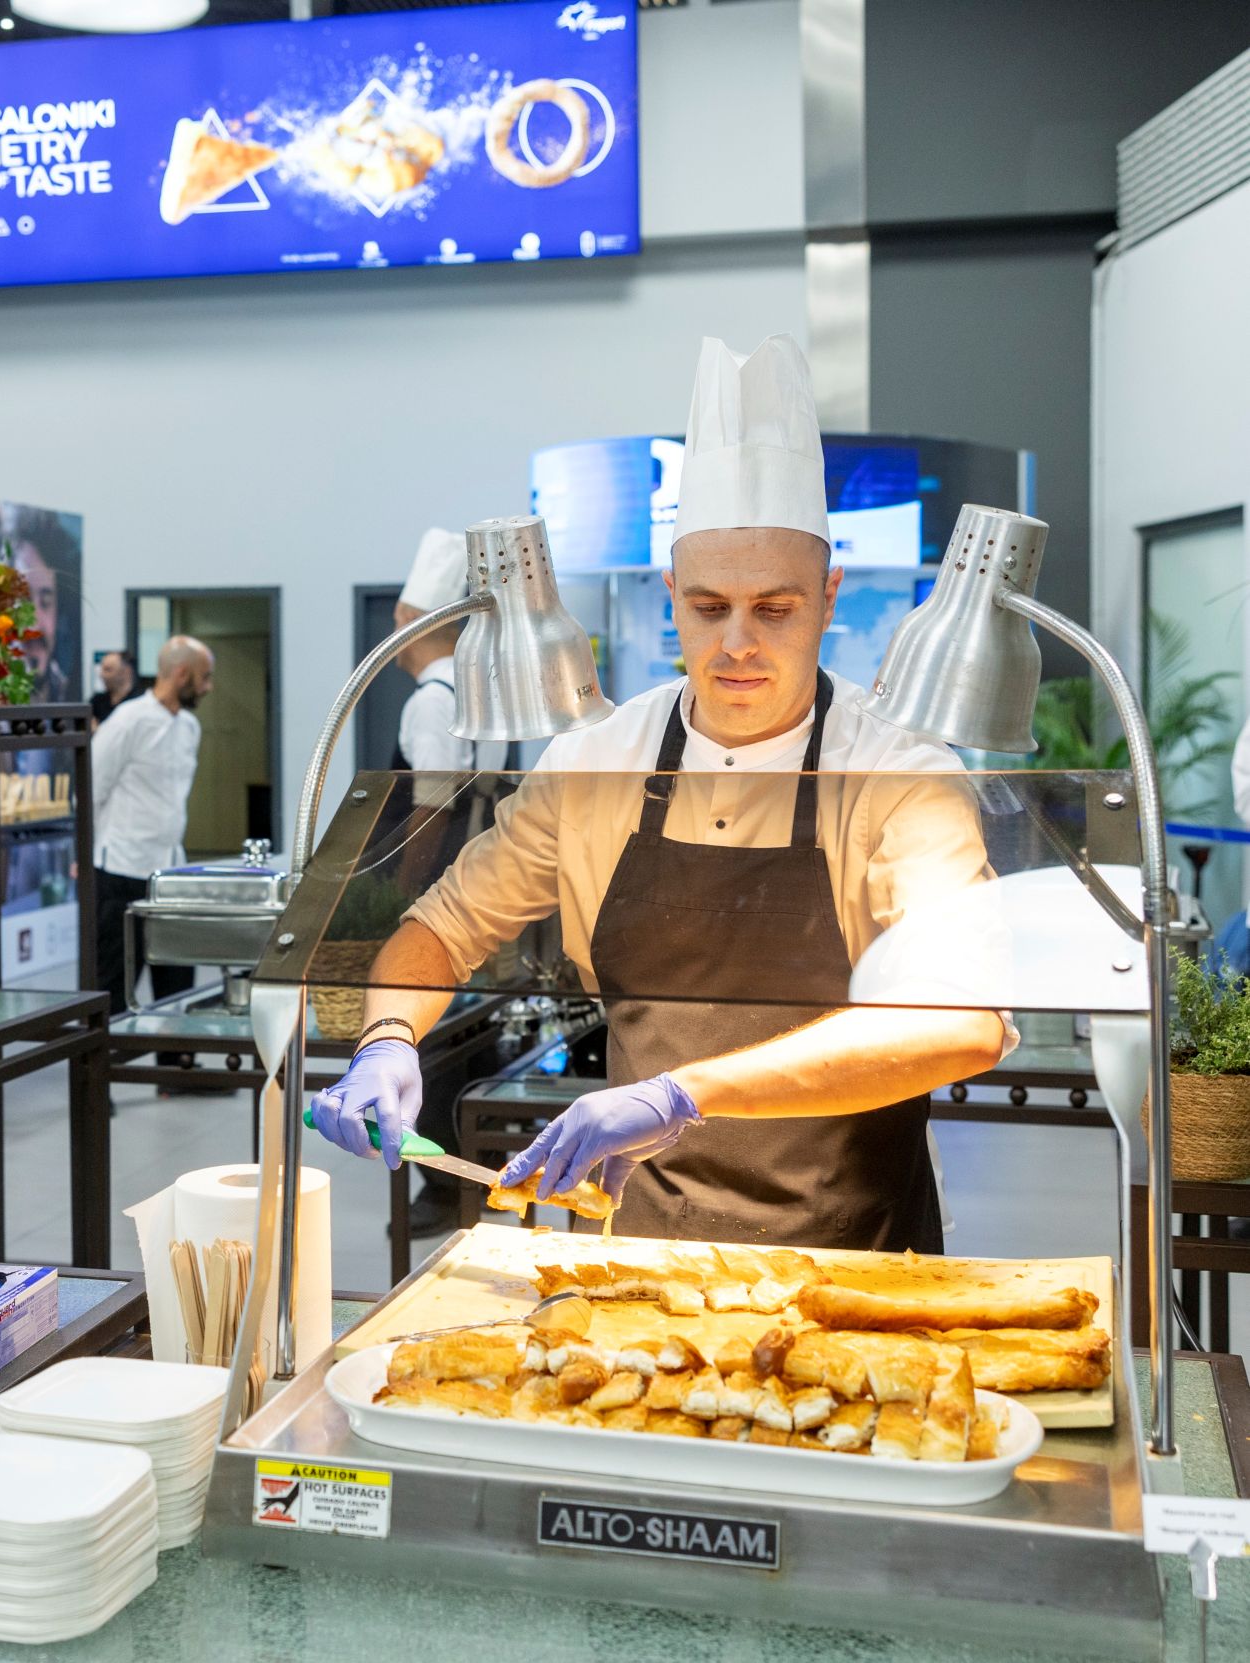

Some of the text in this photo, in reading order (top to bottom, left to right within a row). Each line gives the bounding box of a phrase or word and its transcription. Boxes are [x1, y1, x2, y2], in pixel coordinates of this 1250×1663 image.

[8, 160, 112, 198] TASTE
[302, 1467, 358, 1481] CAUTION
[304, 1482, 387, 1500] HOT SURFACES
